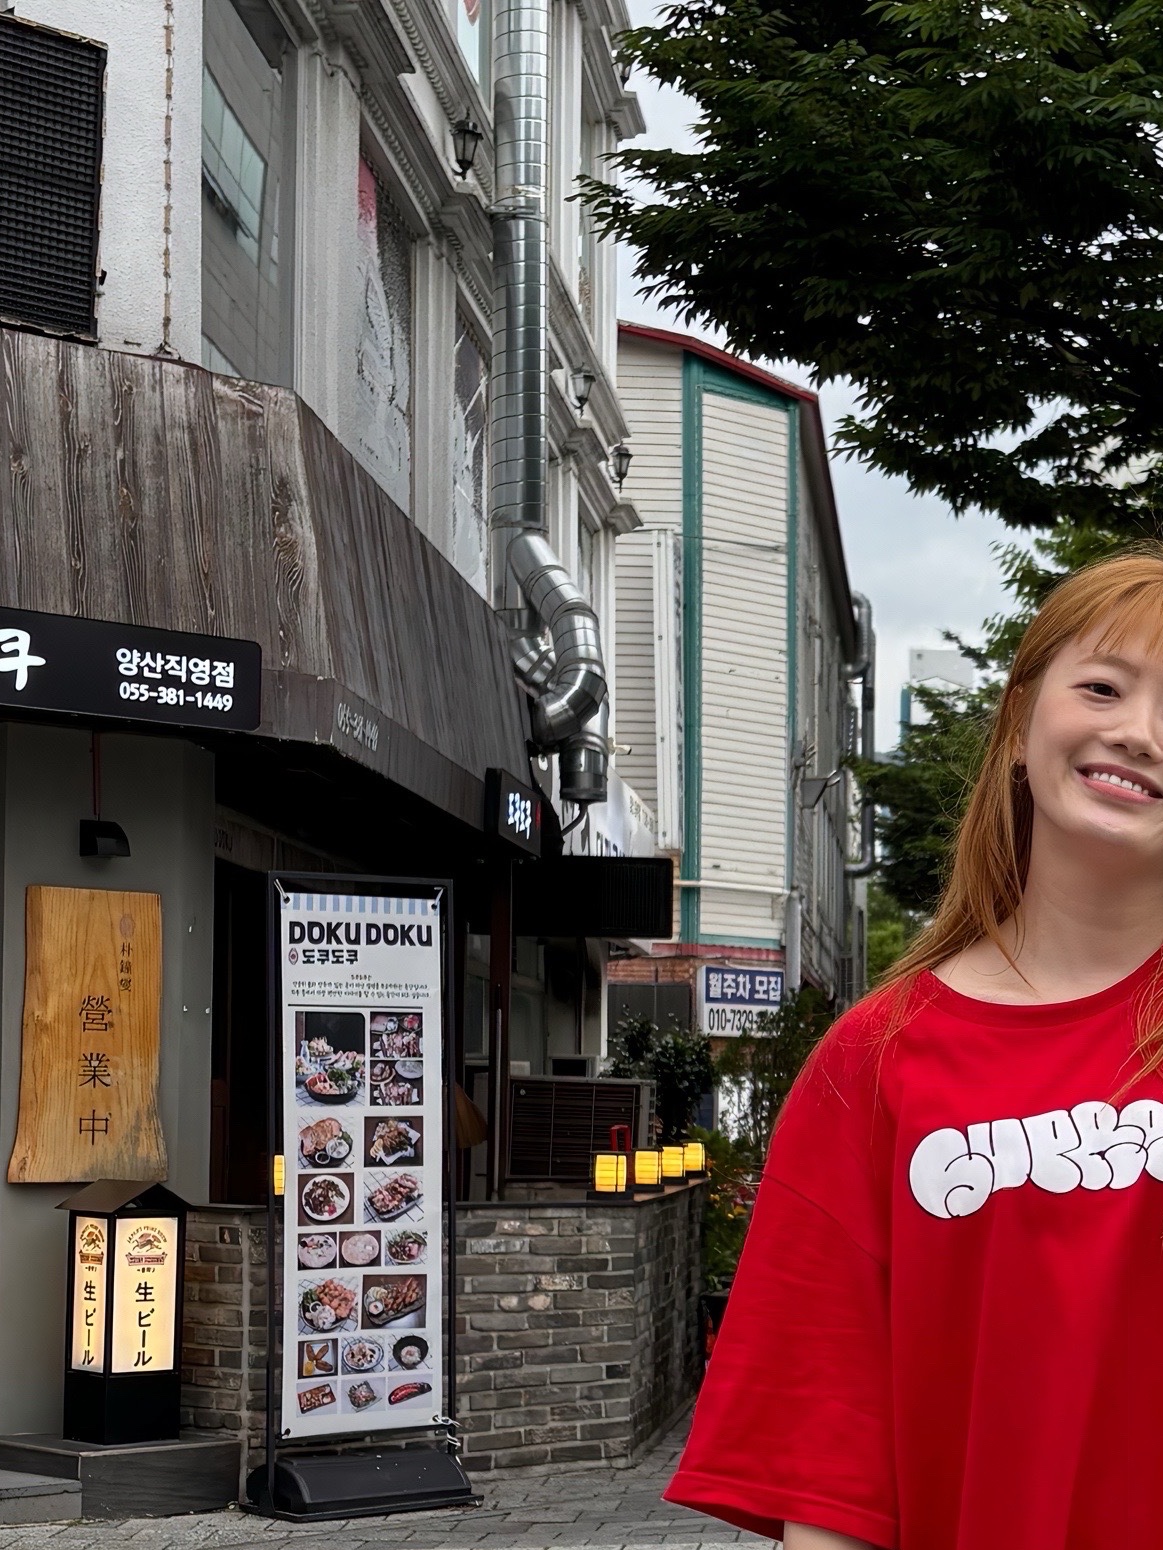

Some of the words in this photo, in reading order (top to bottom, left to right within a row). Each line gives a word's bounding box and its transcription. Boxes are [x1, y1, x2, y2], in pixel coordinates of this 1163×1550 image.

[116, 648, 235, 688] 양산직영점
[119, 682, 233, 712] 055-381-1449
[302, 948, 359, 965] 도쿠도쿠
[708, 972, 751, 1000] 월주차
[754, 975, 781, 1001] 모집
[82, 1280, 97, 1366] 生ビール
[133, 1281, 155, 1367] 生ビール
